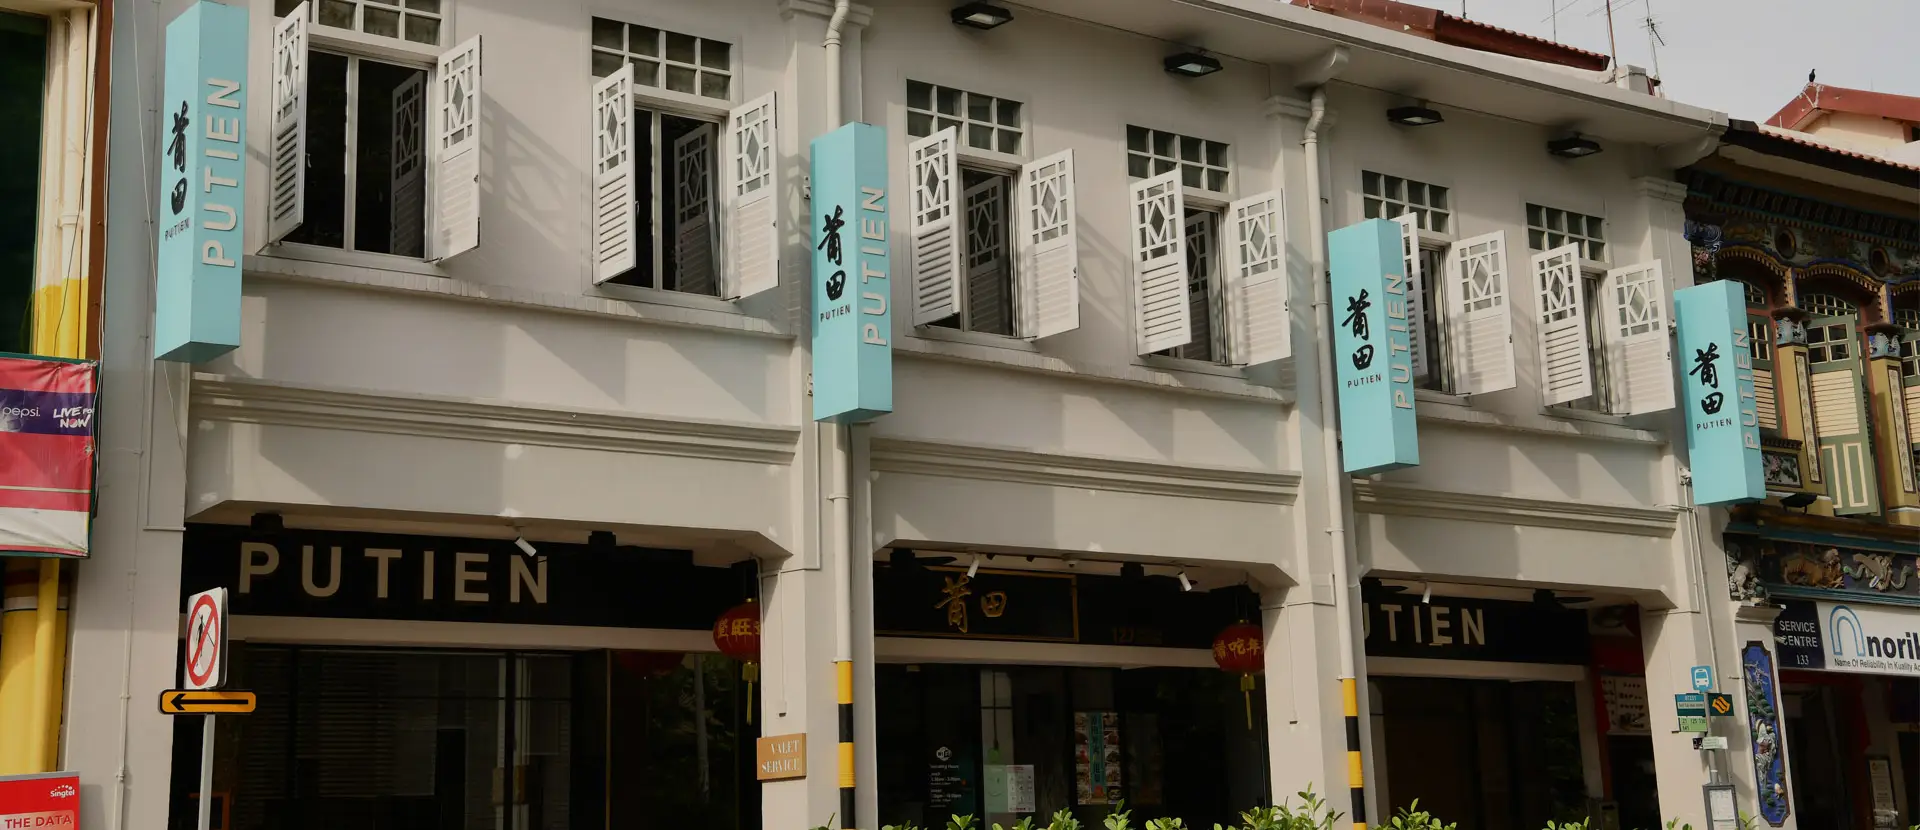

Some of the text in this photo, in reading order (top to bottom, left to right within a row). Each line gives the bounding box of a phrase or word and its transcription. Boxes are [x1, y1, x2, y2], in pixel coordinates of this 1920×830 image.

[167, 99, 190, 216] 莆田
[202, 77, 241, 268] PUTIEN
[164, 217, 190, 241] PUTIEN
[818, 204, 847, 301] 莆田
[861, 186, 888, 346] PUTIEN
[820, 304, 850, 322] PUTIEN
[1341, 288, 1374, 371] 莆田
[1385, 273, 1413, 410] PUTIEN
[1347, 374, 1381, 388] PUTIEN
[1689, 342, 1724, 415] 莆田
[1734, 328, 1760, 450] PUTIEN
[53, 407, 82, 419] LIVE
[1697, 418, 1732, 431] PUTIEN
[238, 541, 548, 604] PUTIEN
[933, 573, 1008, 634] 莆田
[1780, 620, 1816, 633] SERVICE
[1783, 635, 1819, 648] CENTRE
[1796, 654, 1809, 666] 133
[1834, 658, 1851, 668] Name
[1852, 659, 1859, 668] Of
[1860, 660, 1887, 671] Reliability
[1887, 661, 1894, 669] In
[771, 739, 800, 755] VALET
[761, 757, 800, 773] SERVICE
[50, 788, 75, 798] Singtel
[4, 814, 72, 829] THE DATA
